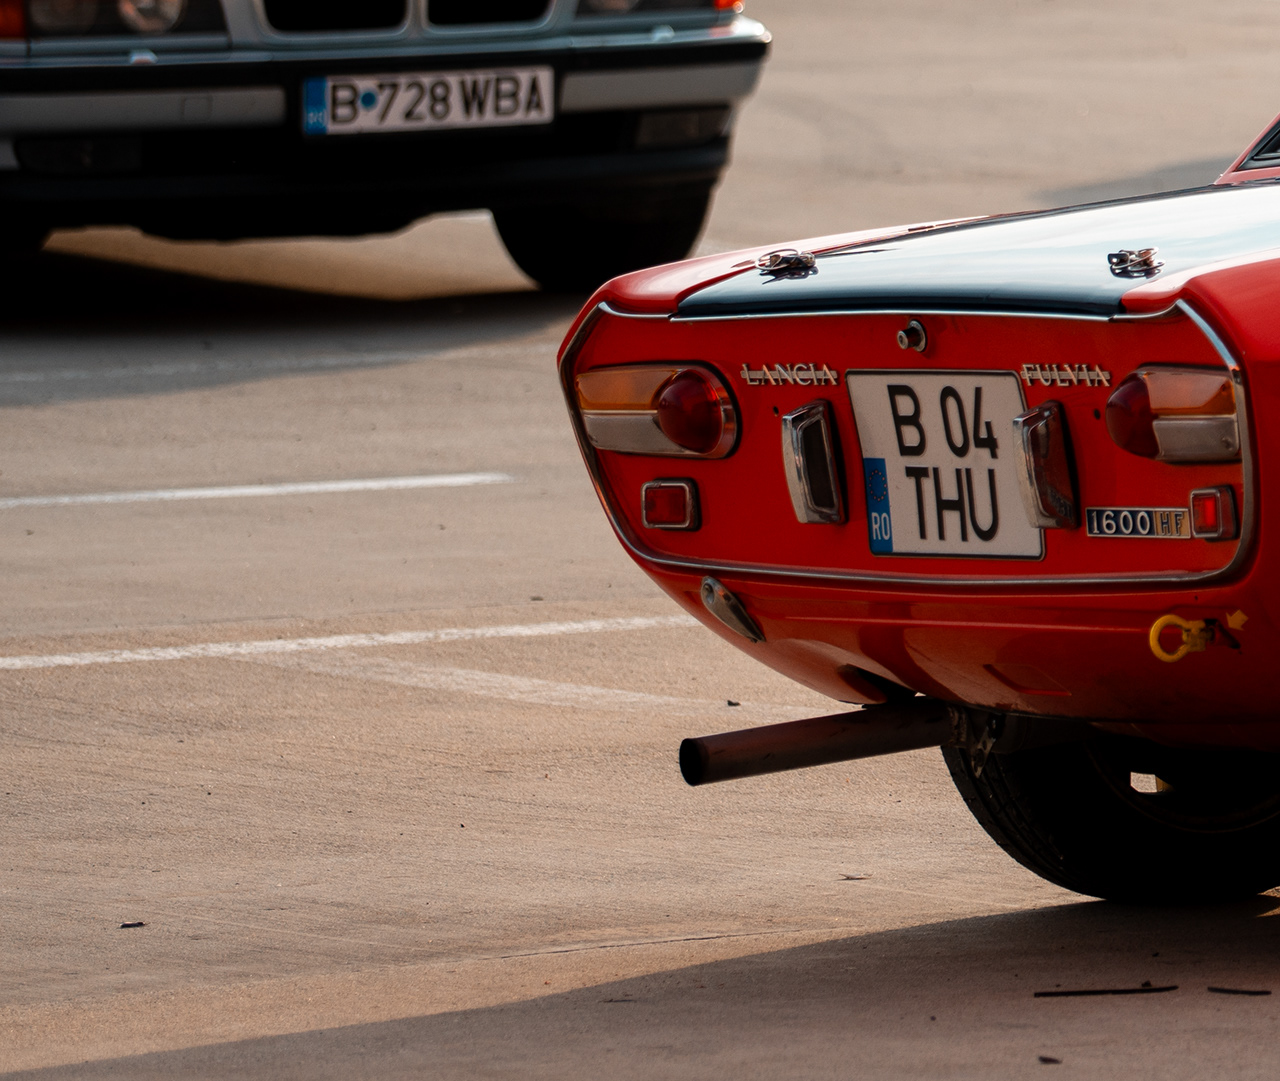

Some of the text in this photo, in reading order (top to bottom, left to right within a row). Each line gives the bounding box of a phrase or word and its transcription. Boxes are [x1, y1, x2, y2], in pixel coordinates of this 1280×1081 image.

[330, 74, 545, 123] B 728 WBA
[740, 362, 838, 387] LANCIA
[1021, 363, 1111, 388] FULVIA
[887, 384, 999, 459] B 04
[905, 466, 999, 542] THU
[871, 511, 890, 541] RO
[1089, 509, 1185, 535] 1600 HF
